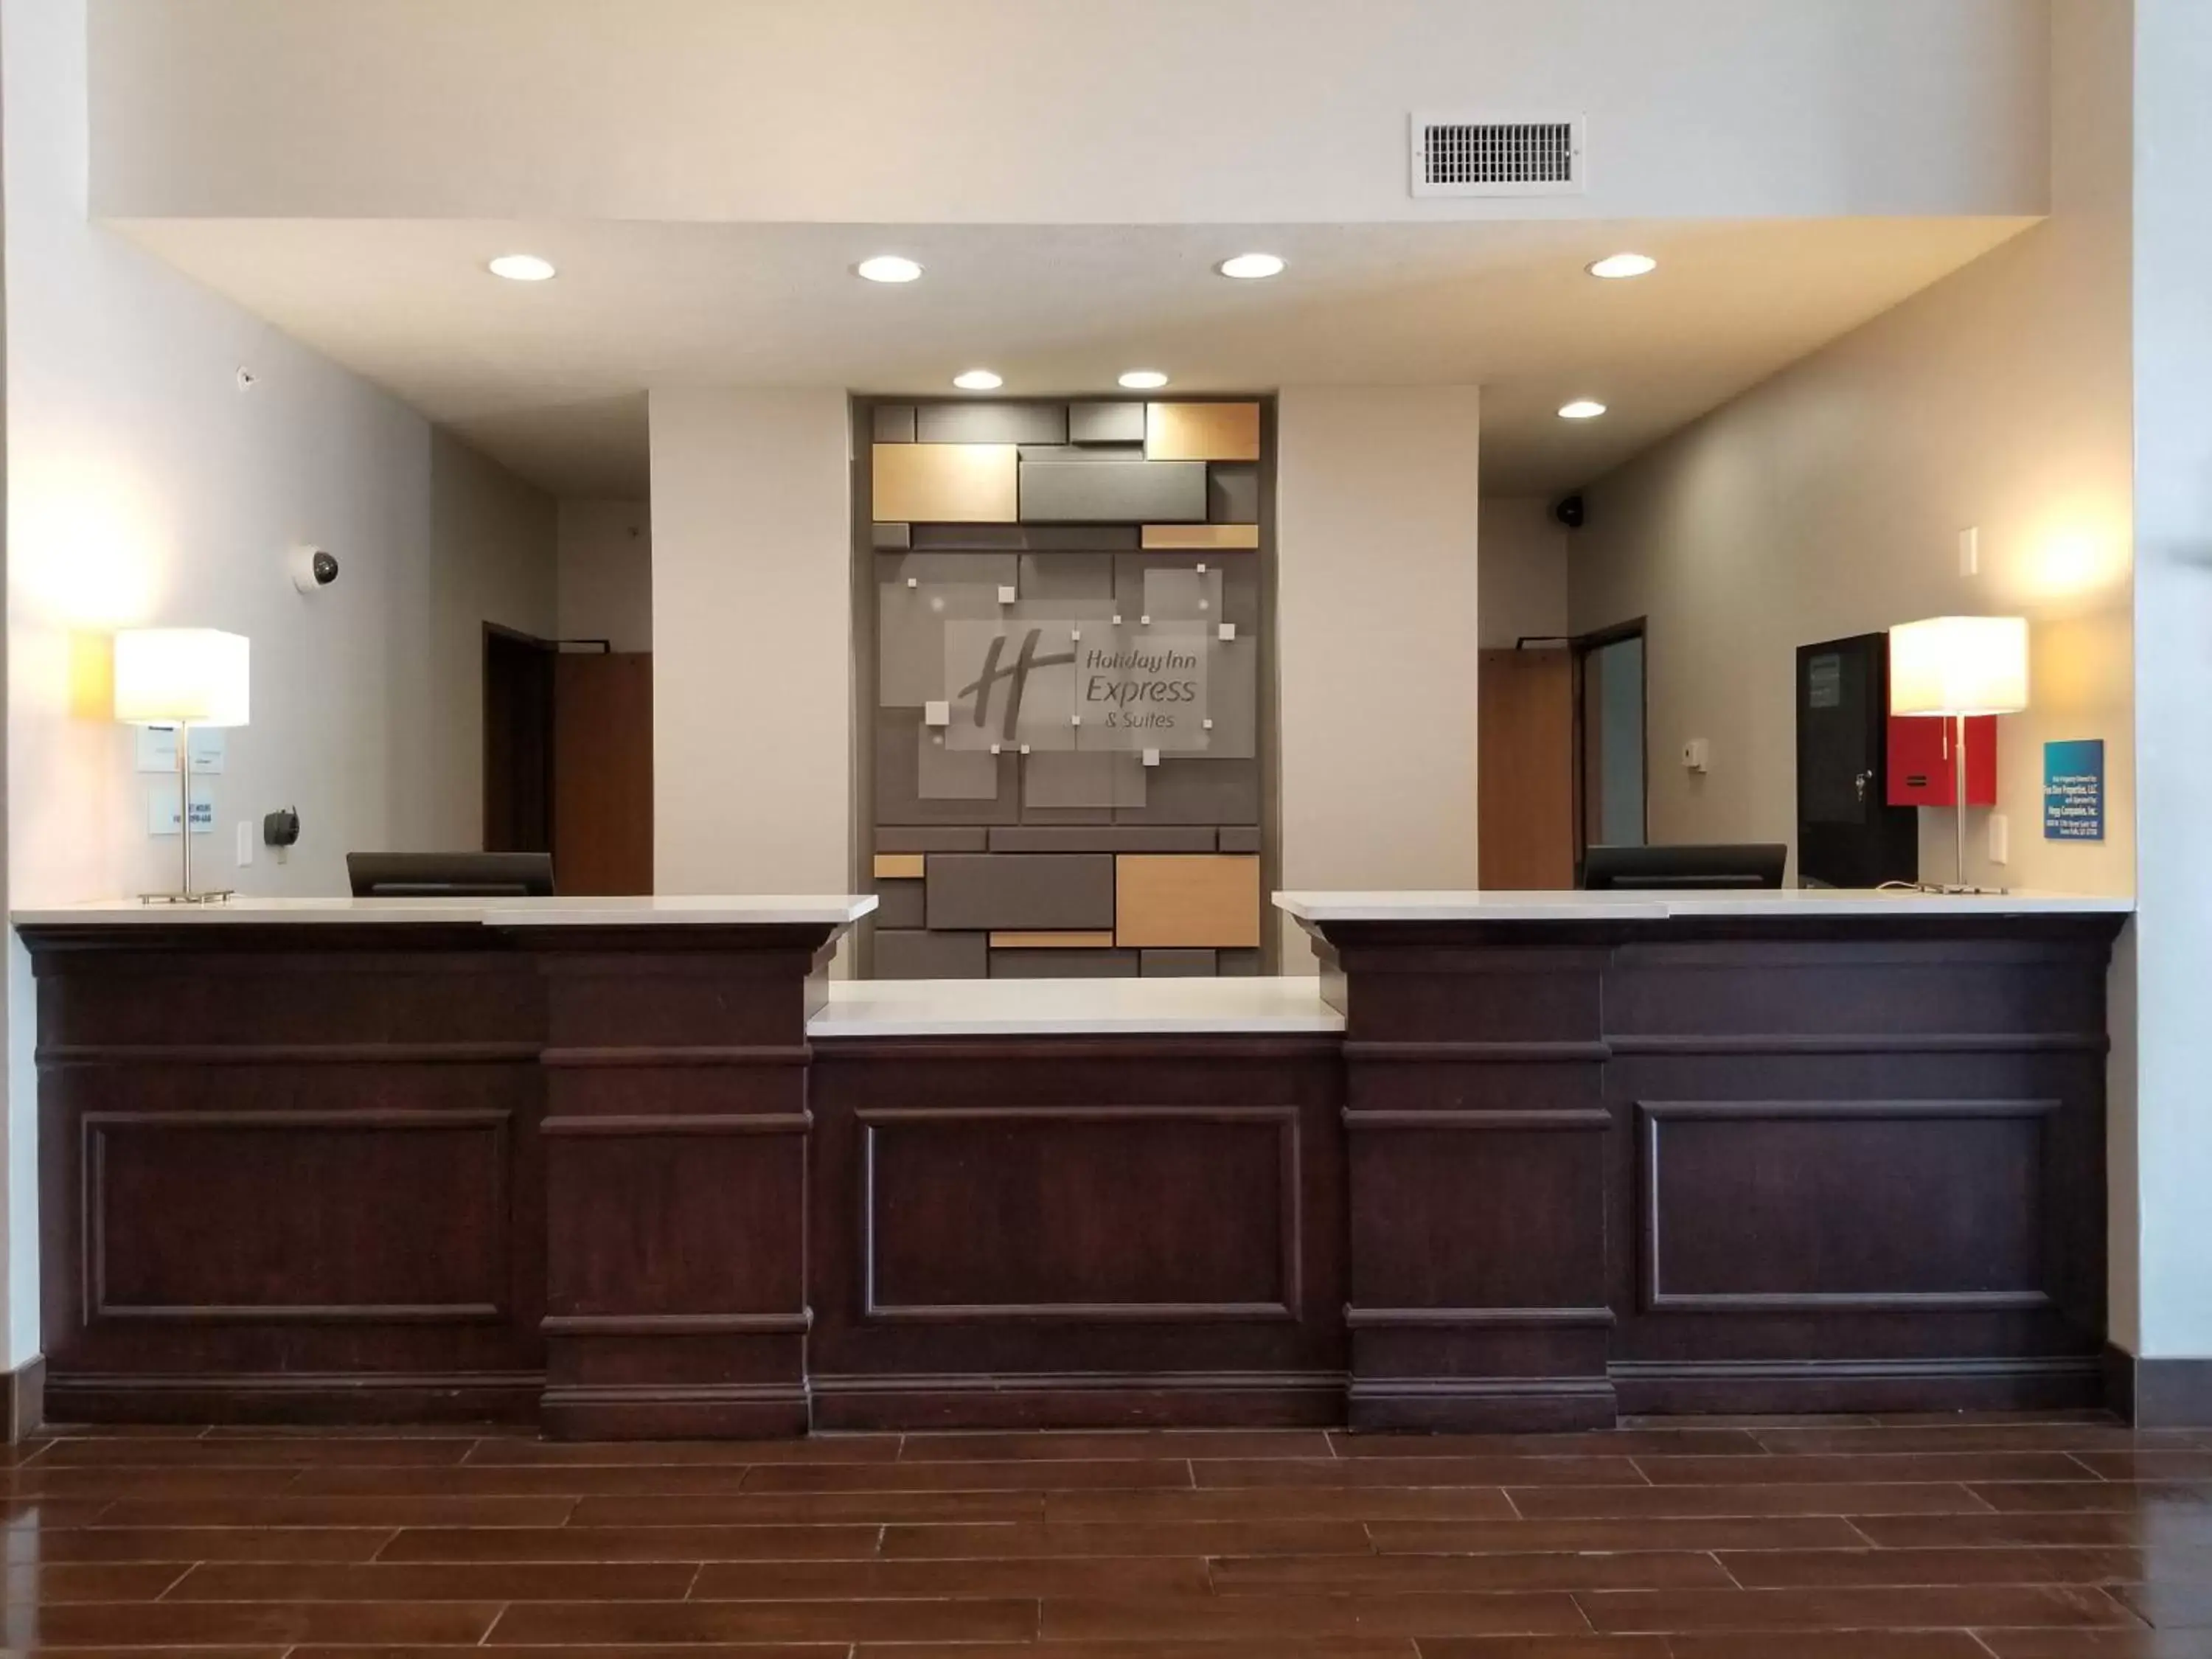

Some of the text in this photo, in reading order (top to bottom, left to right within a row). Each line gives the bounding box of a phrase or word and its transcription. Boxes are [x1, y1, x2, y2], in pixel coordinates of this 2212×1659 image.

[1087, 649, 1197, 672] Holiday Inn
[1087, 675, 1197, 708] Express
[1106, 712, 1175, 728] & Suites
